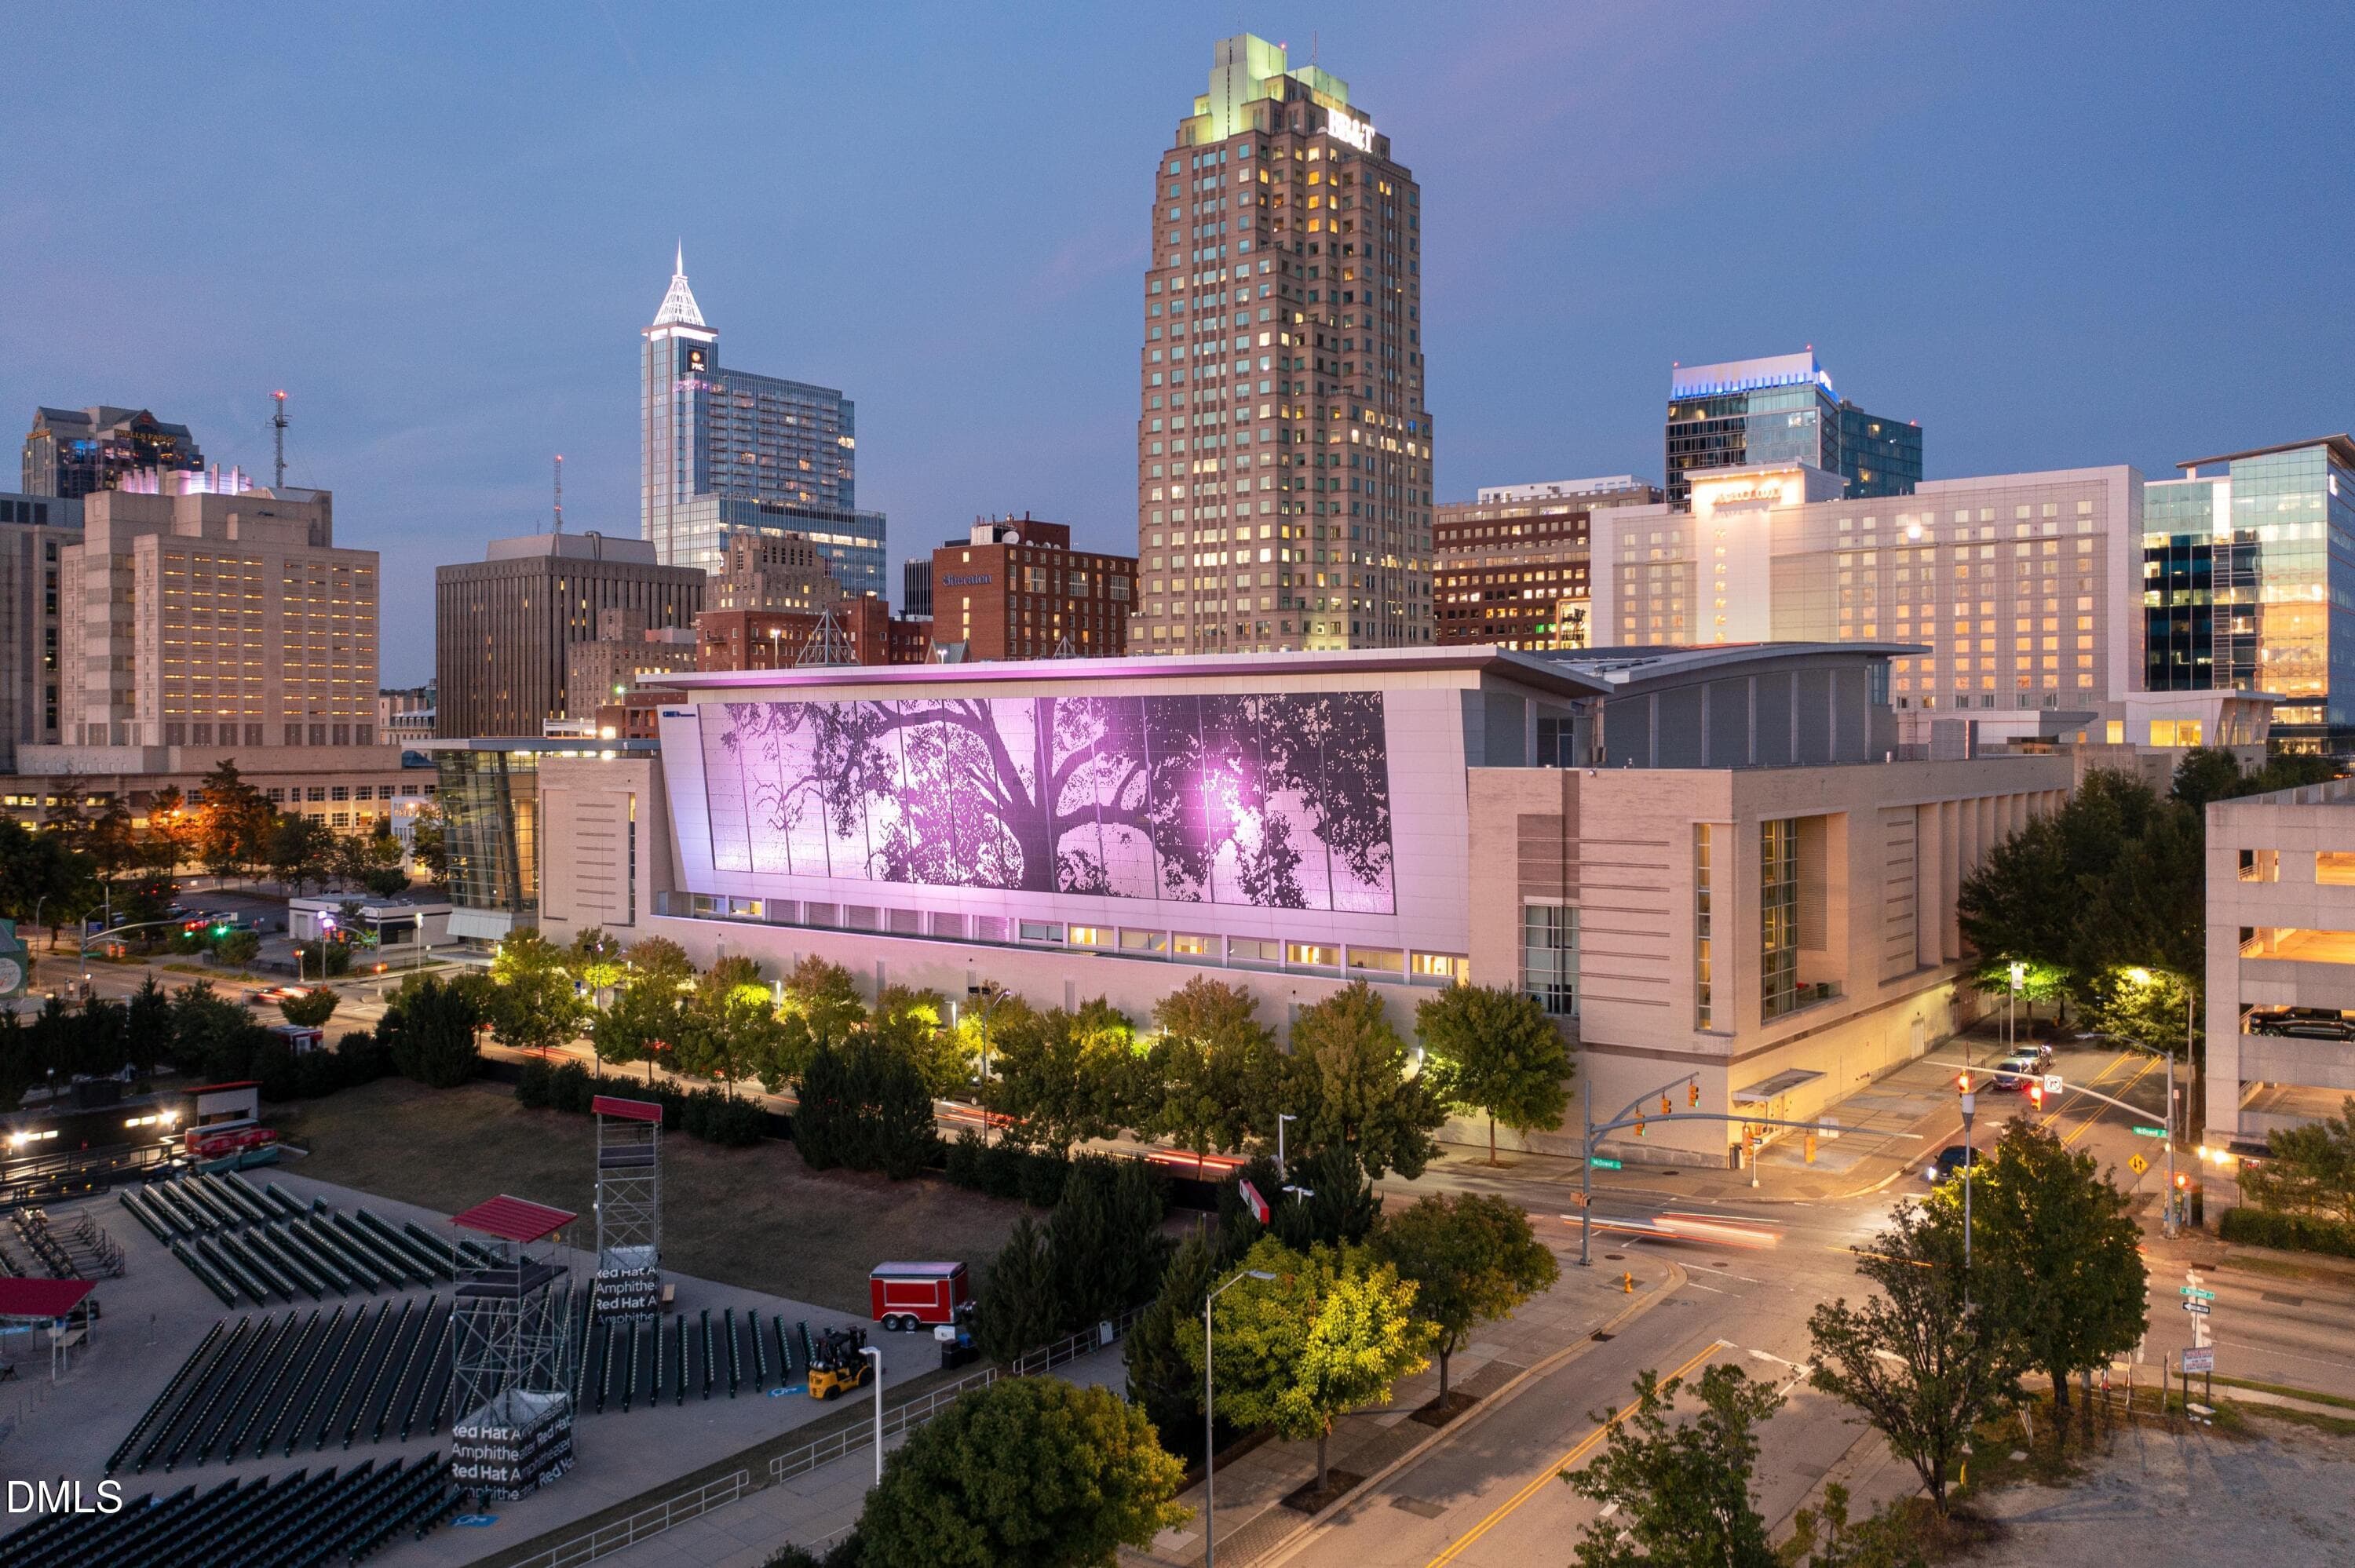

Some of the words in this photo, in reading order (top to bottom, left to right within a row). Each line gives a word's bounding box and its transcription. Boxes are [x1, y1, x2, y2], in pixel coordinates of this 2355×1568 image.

[692, 362, 705, 372] PNC
[116, 430, 147, 440] WELLS
[148, 432, 177, 444] FARGO
[943, 573, 992, 586] Sheraton
[597, 1280, 656, 1296] Amphithe
[621, 1296, 645, 1309] Hat
[480, 1463, 508, 1482] Hat
